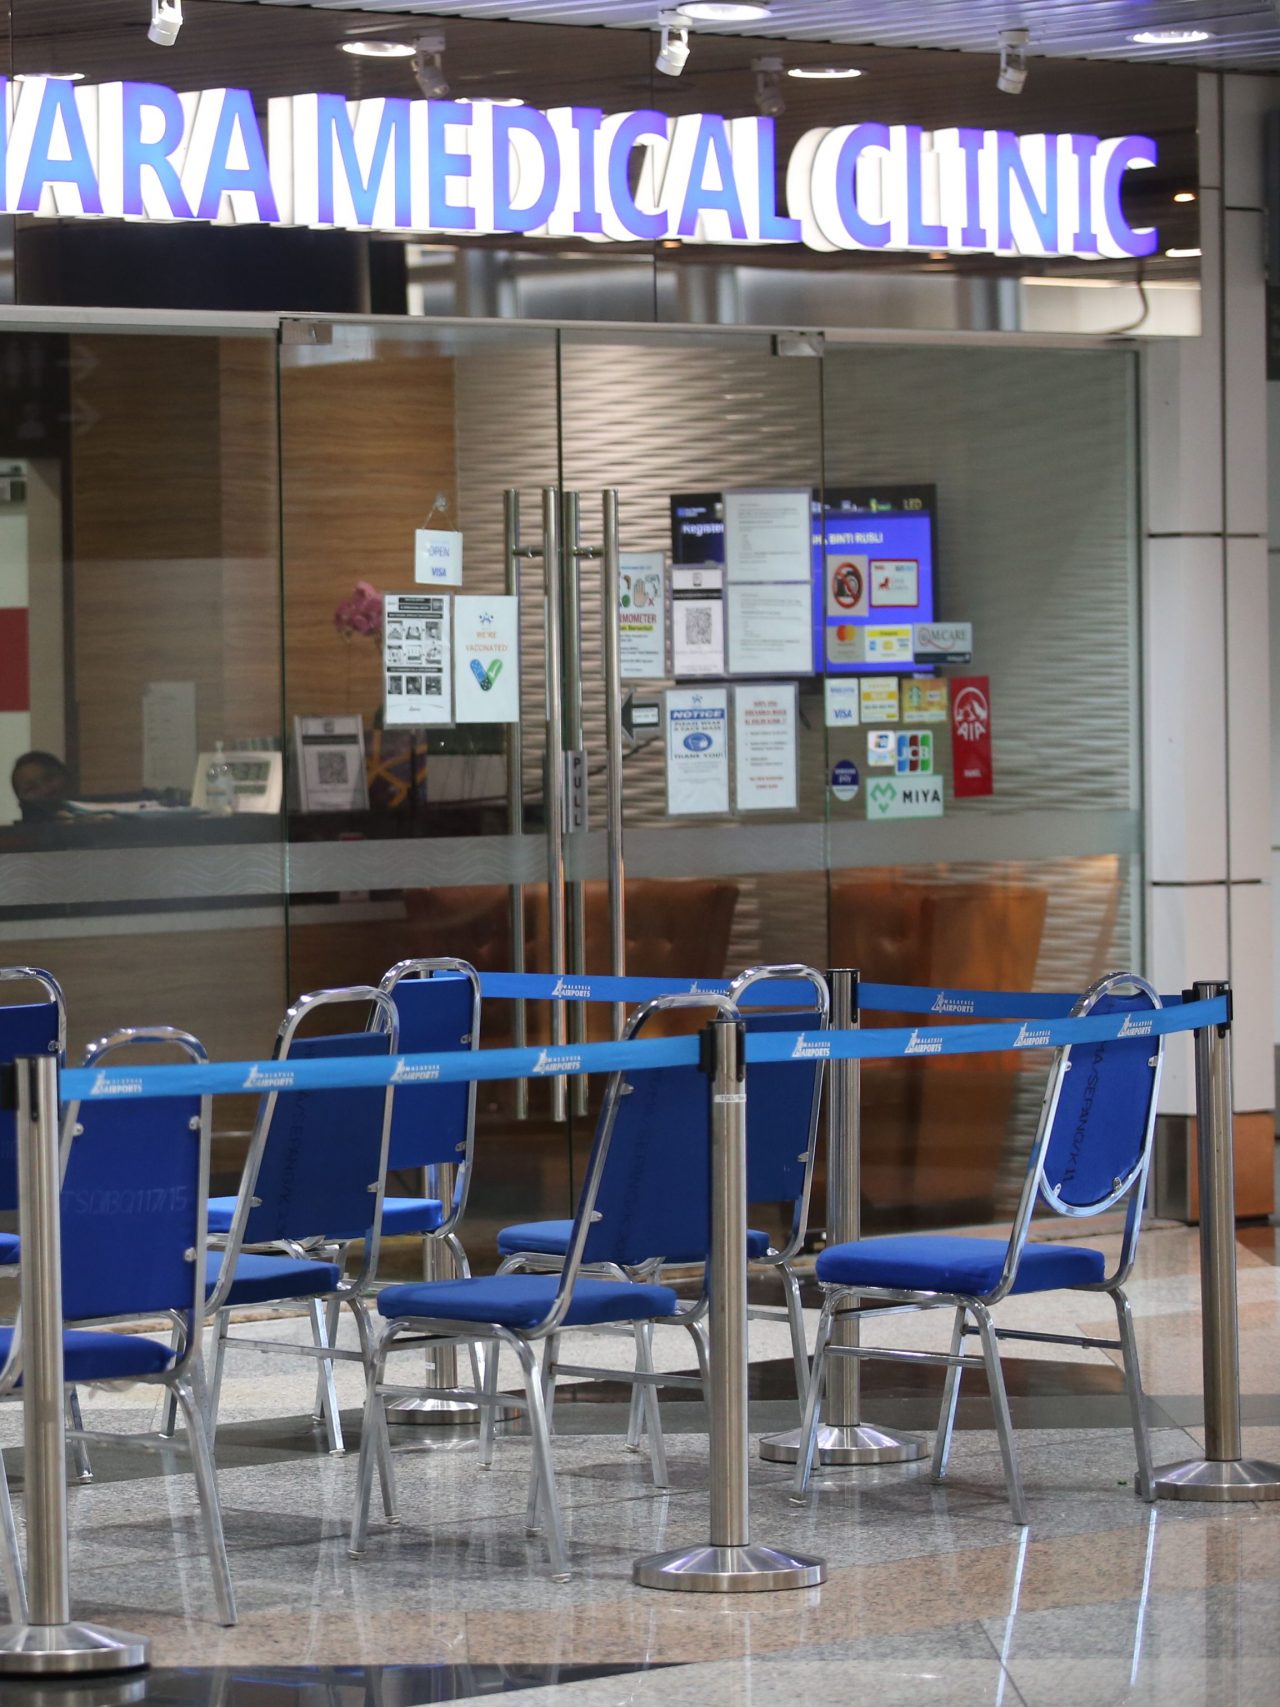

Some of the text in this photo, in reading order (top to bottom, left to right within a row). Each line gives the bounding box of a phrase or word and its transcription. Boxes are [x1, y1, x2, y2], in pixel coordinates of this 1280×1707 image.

[317, 92, 801, 240] MEDICAL
[835, 122, 1158, 259] CLINIC
[431, 567, 447, 577] VISA
[673, 709, 723, 719] NOTICE
[833, 708, 853, 719] VISA
[898, 745, 931, 758] JCB
[903, 789, 941, 804] MIYA
[560, 989, 590, 998] AIRPORTS
[941, 1005, 974, 1013] AIRPORTS
[1125, 1026, 1152, 1037] AIRPORTS
[1022, 1036, 1050, 1046] AIRPORTS
[800, 1047, 831, 1057] AIRPORTS
[913, 1043, 942, 1053] AIRPORTS
[545, 1060, 581, 1071] AIRPORTS
[402, 1070, 440, 1080] AIRPORTS
[255, 1077, 294, 1088] AIRPORTS
[103, 1083, 143, 1094] AIRPORTS
